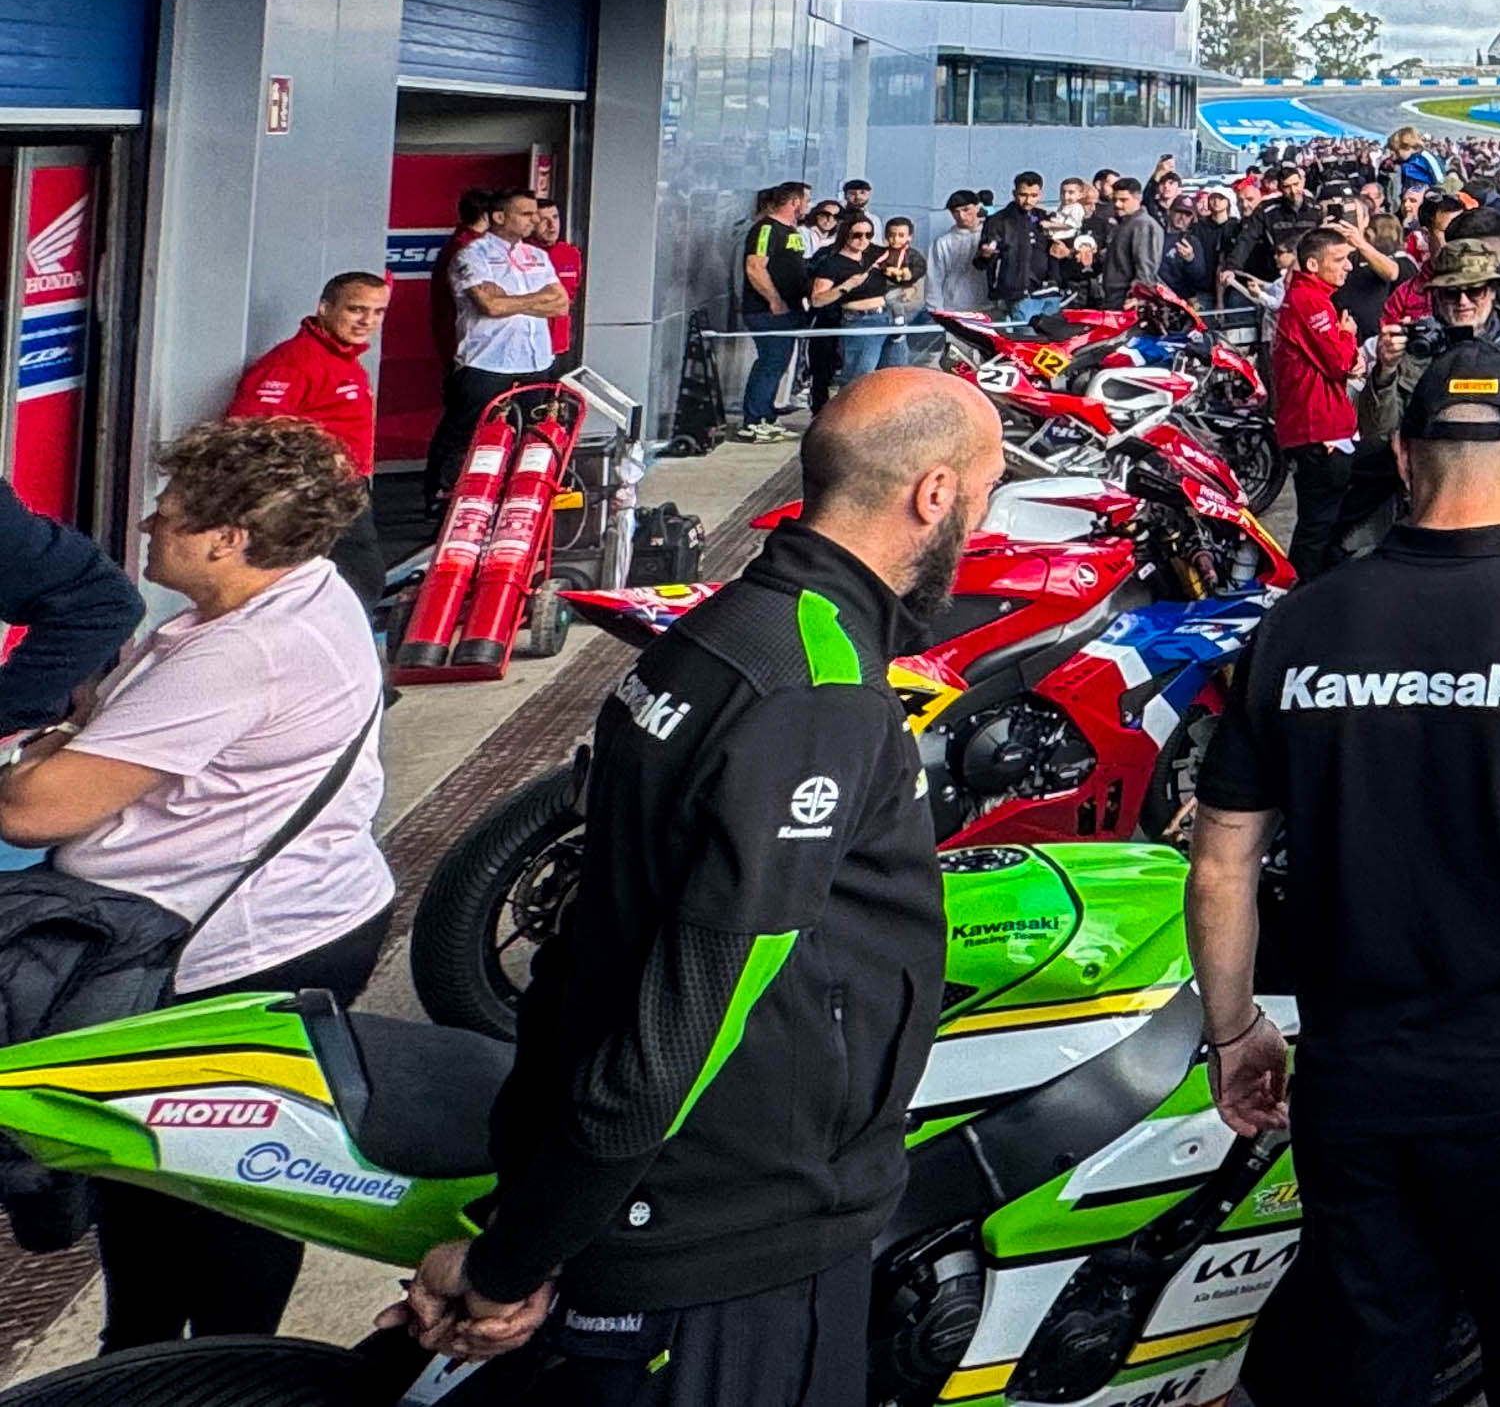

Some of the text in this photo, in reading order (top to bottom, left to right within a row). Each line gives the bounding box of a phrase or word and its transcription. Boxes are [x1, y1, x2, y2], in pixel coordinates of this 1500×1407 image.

[25, 271, 85, 294] HONDA
[1037, 349, 1064, 375] 12
[979, 369, 1017, 387] 21
[951, 915, 1060, 940] Kawasaki
[151, 1102, 273, 1125] MOTUL
[284, 1158, 408, 1201] Claqueta
[565, 1308, 644, 1332] Kawasaki
